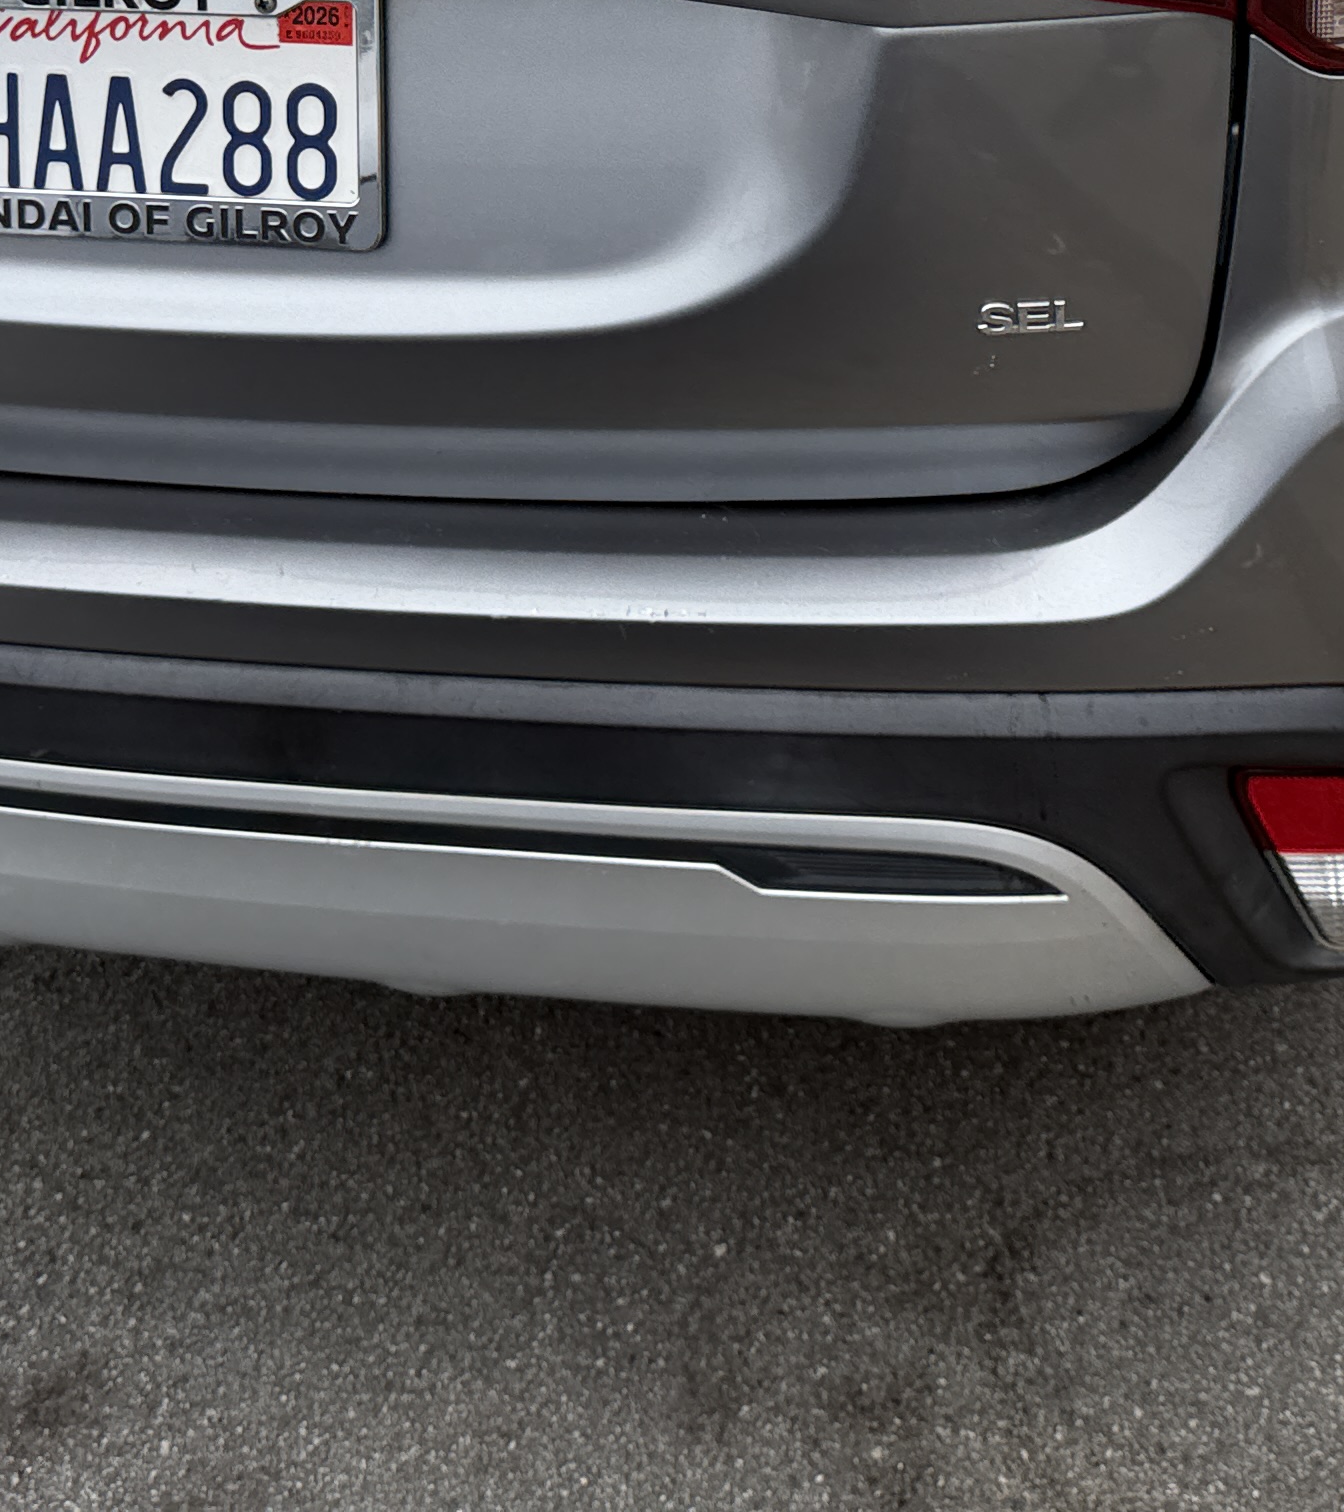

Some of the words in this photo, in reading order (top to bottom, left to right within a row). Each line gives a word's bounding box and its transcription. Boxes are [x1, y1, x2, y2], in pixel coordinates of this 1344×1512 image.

[292, 5, 340, 27] 2026
[109, 203, 171, 236] OF
[186, 205, 359, 245] GILROY
[976, 299, 1085, 336] SEL
